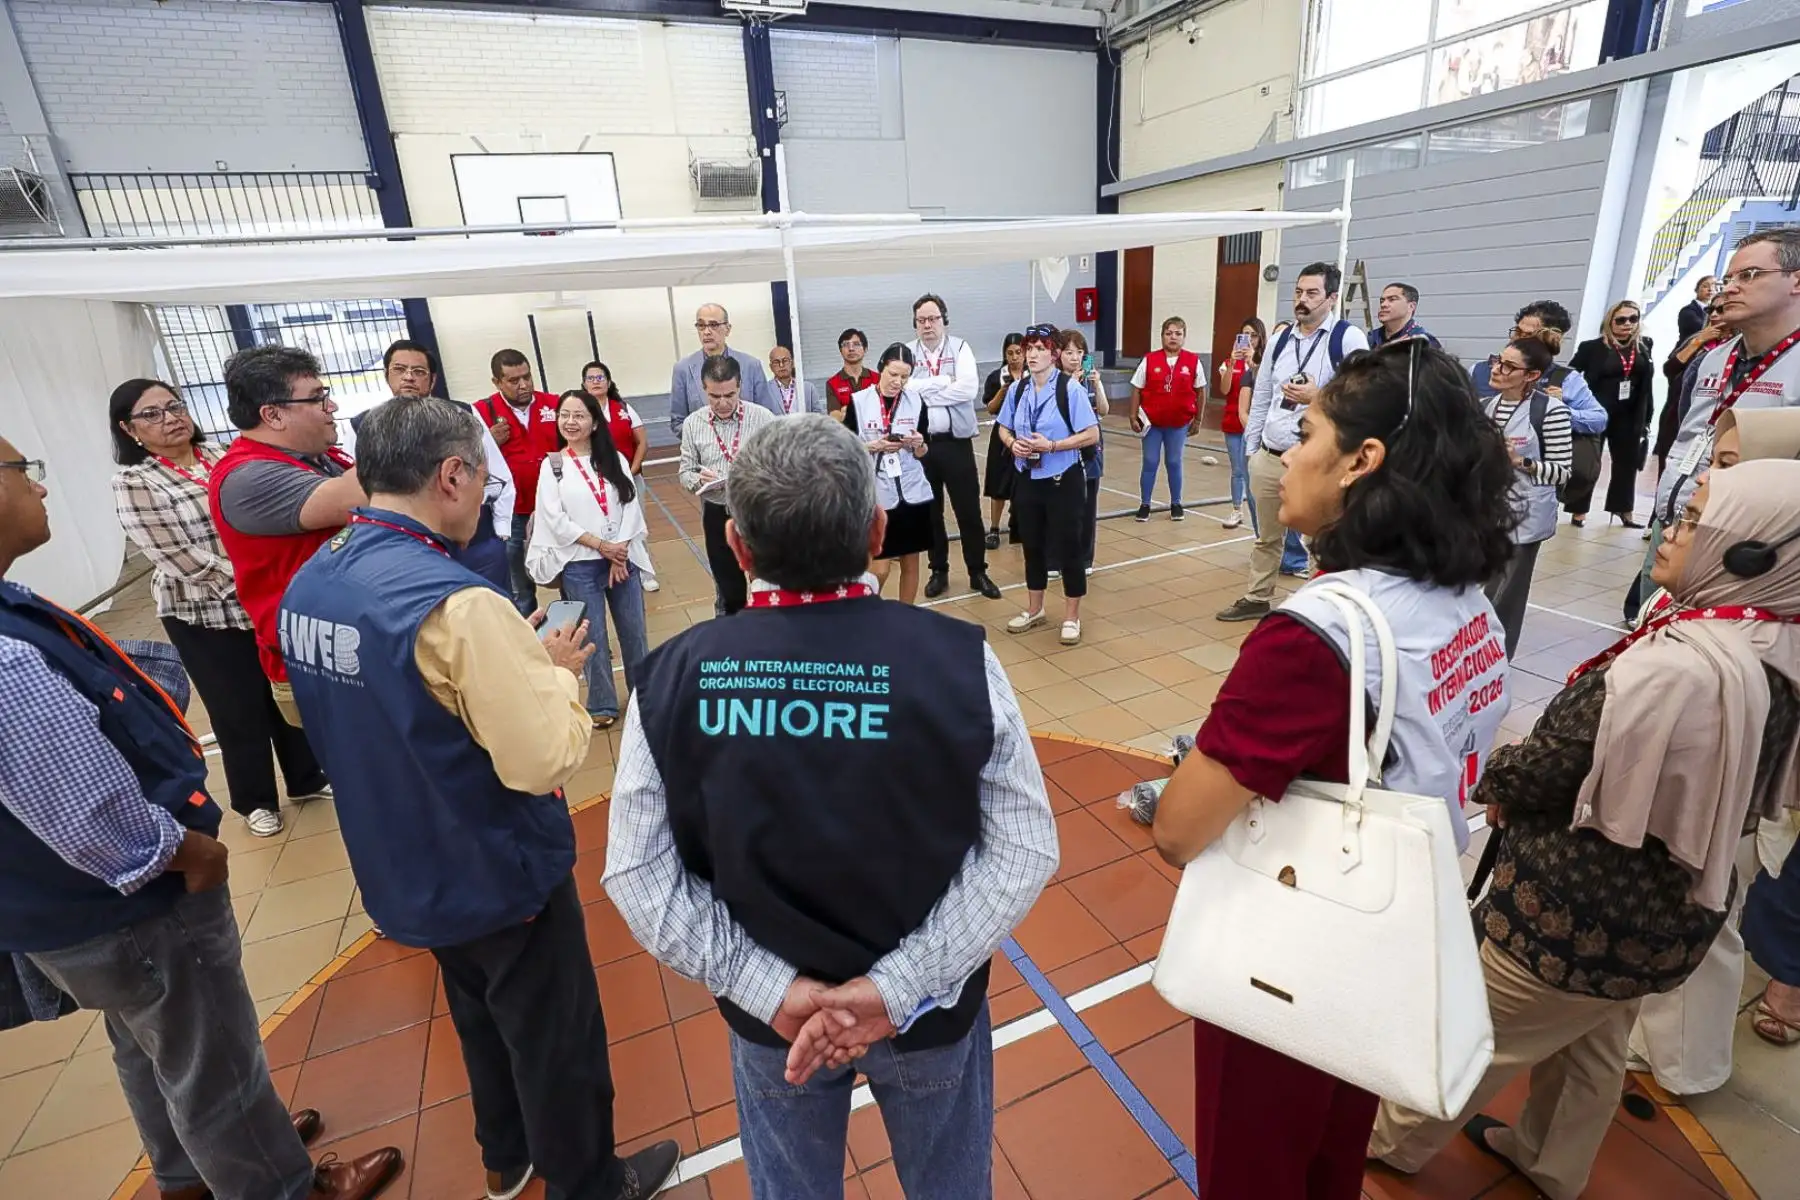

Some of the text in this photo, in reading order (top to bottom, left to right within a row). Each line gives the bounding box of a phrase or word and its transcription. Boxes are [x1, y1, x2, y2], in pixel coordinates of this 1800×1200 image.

[701, 657, 890, 677] UNIÓN INTERAMERICANA DE
[699, 677, 890, 694] ORGANISMOS ELECTORALES
[1469, 673, 1505, 714] 2026
[699, 698, 890, 739] UNIORE
